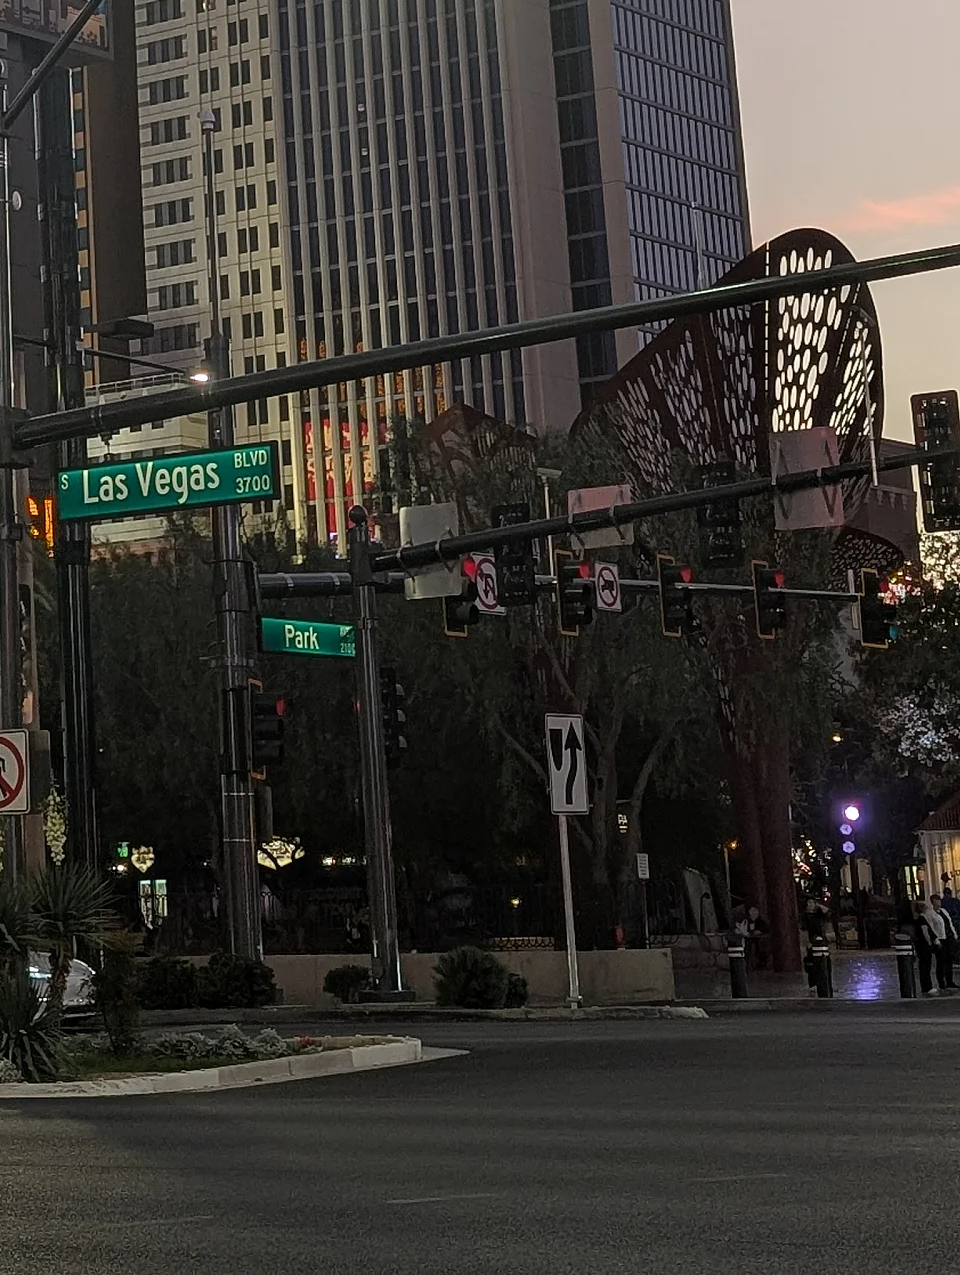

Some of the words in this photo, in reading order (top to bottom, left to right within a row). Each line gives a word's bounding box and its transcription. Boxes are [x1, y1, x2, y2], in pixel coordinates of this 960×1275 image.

[234, 450, 268, 469] BLVD
[61, 474, 69, 490] S
[82, 469, 129, 505] Las
[135, 461, 221, 505] Vegas
[235, 474, 270, 494] 3700
[284, 624, 320, 650] Park
